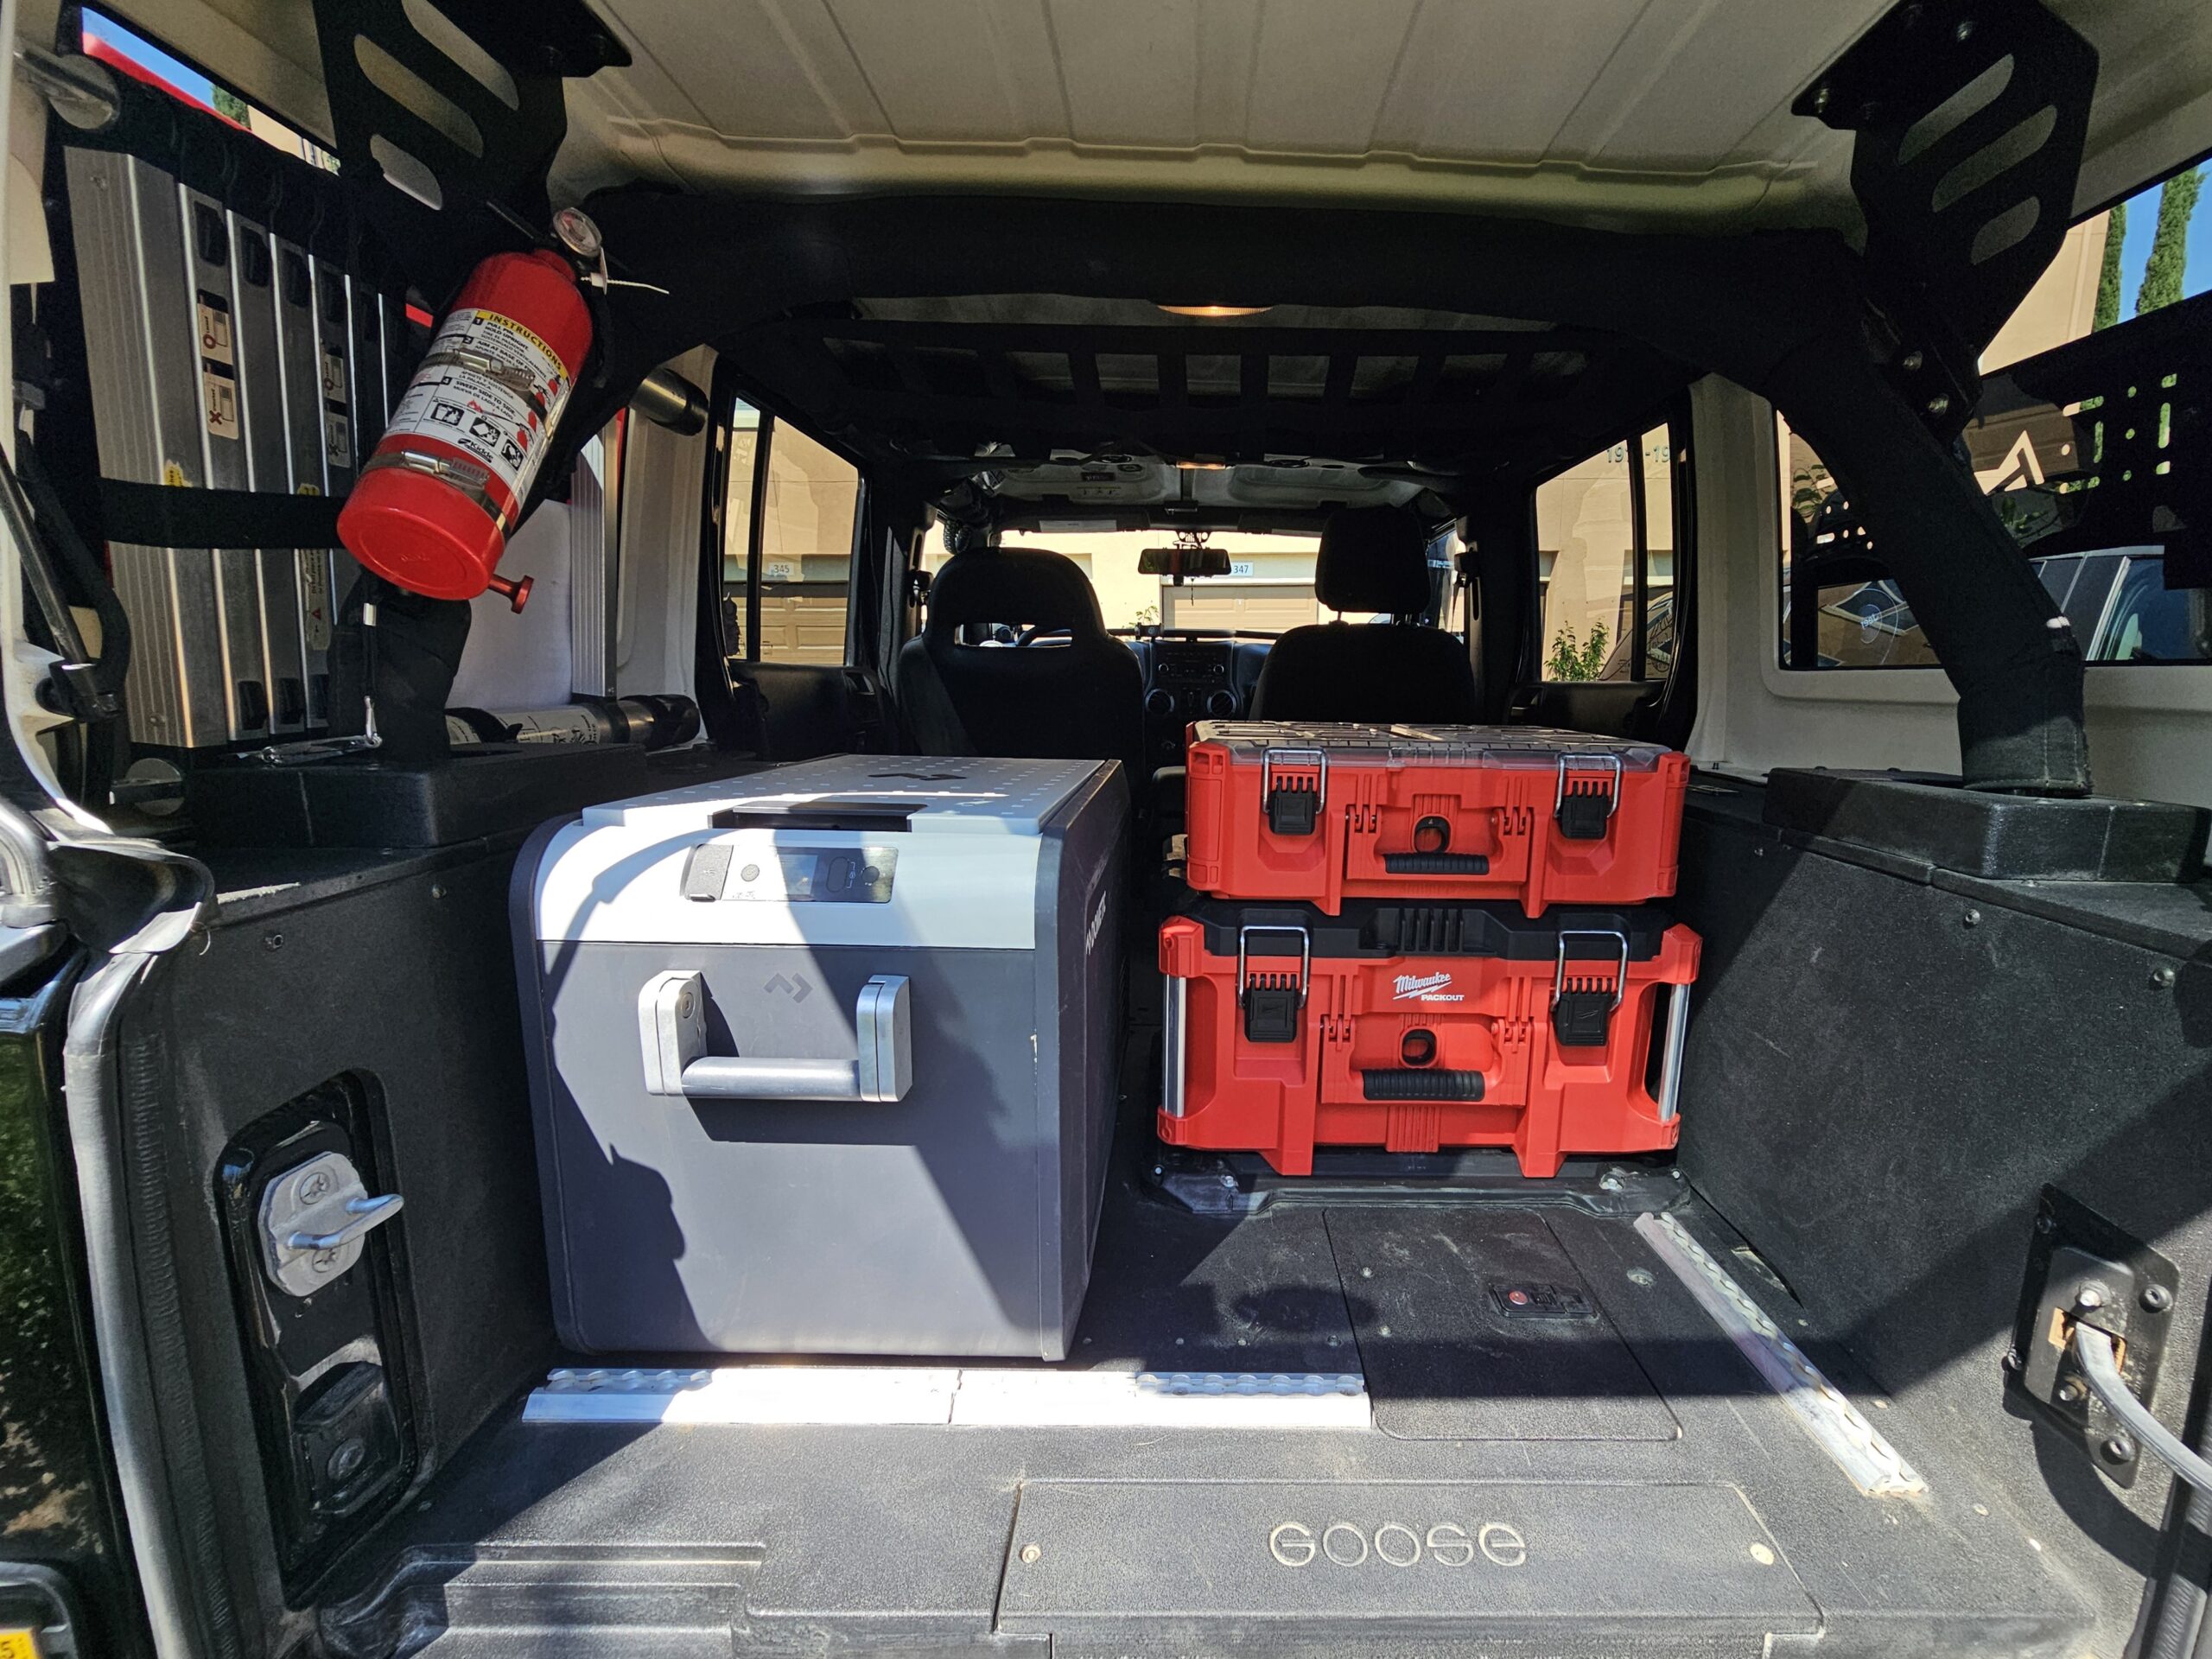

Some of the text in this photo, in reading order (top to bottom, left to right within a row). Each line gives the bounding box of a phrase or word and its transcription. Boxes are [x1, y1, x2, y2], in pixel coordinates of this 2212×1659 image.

[485, 326, 502, 334] HOLD
[489, 314, 562, 371] INSTRUCTIONS
[456, 380, 478, 391] SWEEP
[478, 388, 493, 398] SIDE
[493, 397, 502, 405] TO
[470, 441, 494, 460] Kidde
[773, 564, 790, 574] 345
[1234, 564, 1249, 574] 347
[1392, 971, 1452, 995] Milwaukee
